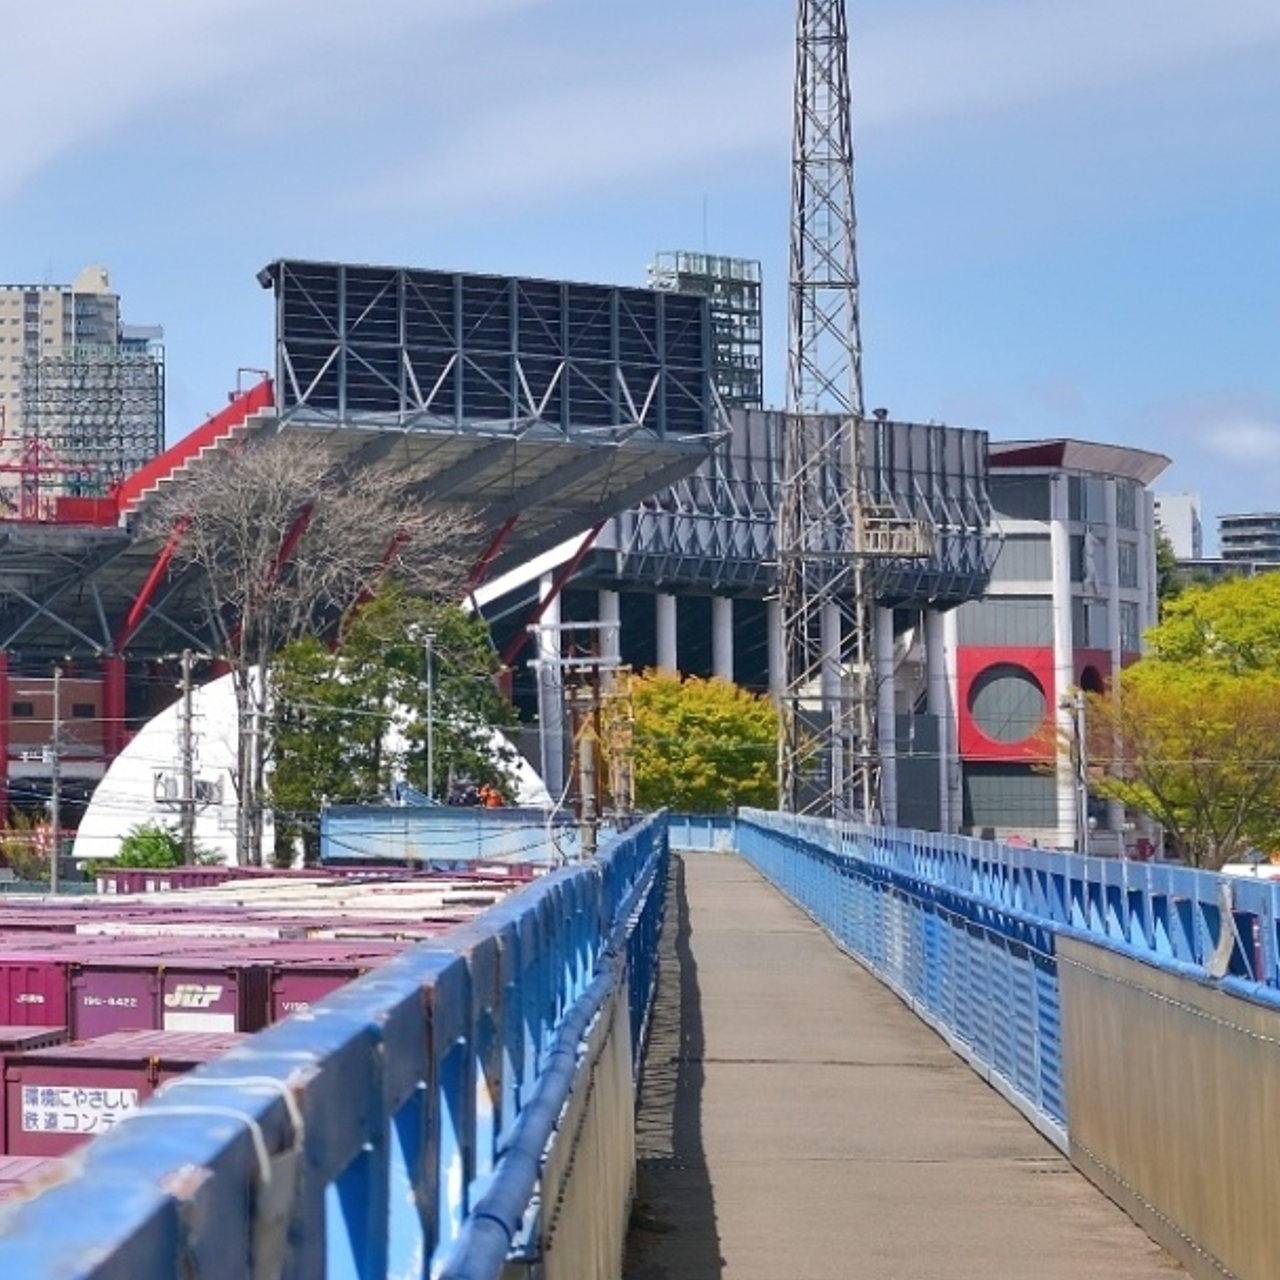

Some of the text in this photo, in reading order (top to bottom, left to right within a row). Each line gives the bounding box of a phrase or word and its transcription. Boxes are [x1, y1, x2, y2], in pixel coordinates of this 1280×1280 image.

[164, 984, 223, 1008] JRF
[23, 1086, 137, 1108] 環境にやさしい
[23, 1111, 118, 1131] 鉄道コンテ
